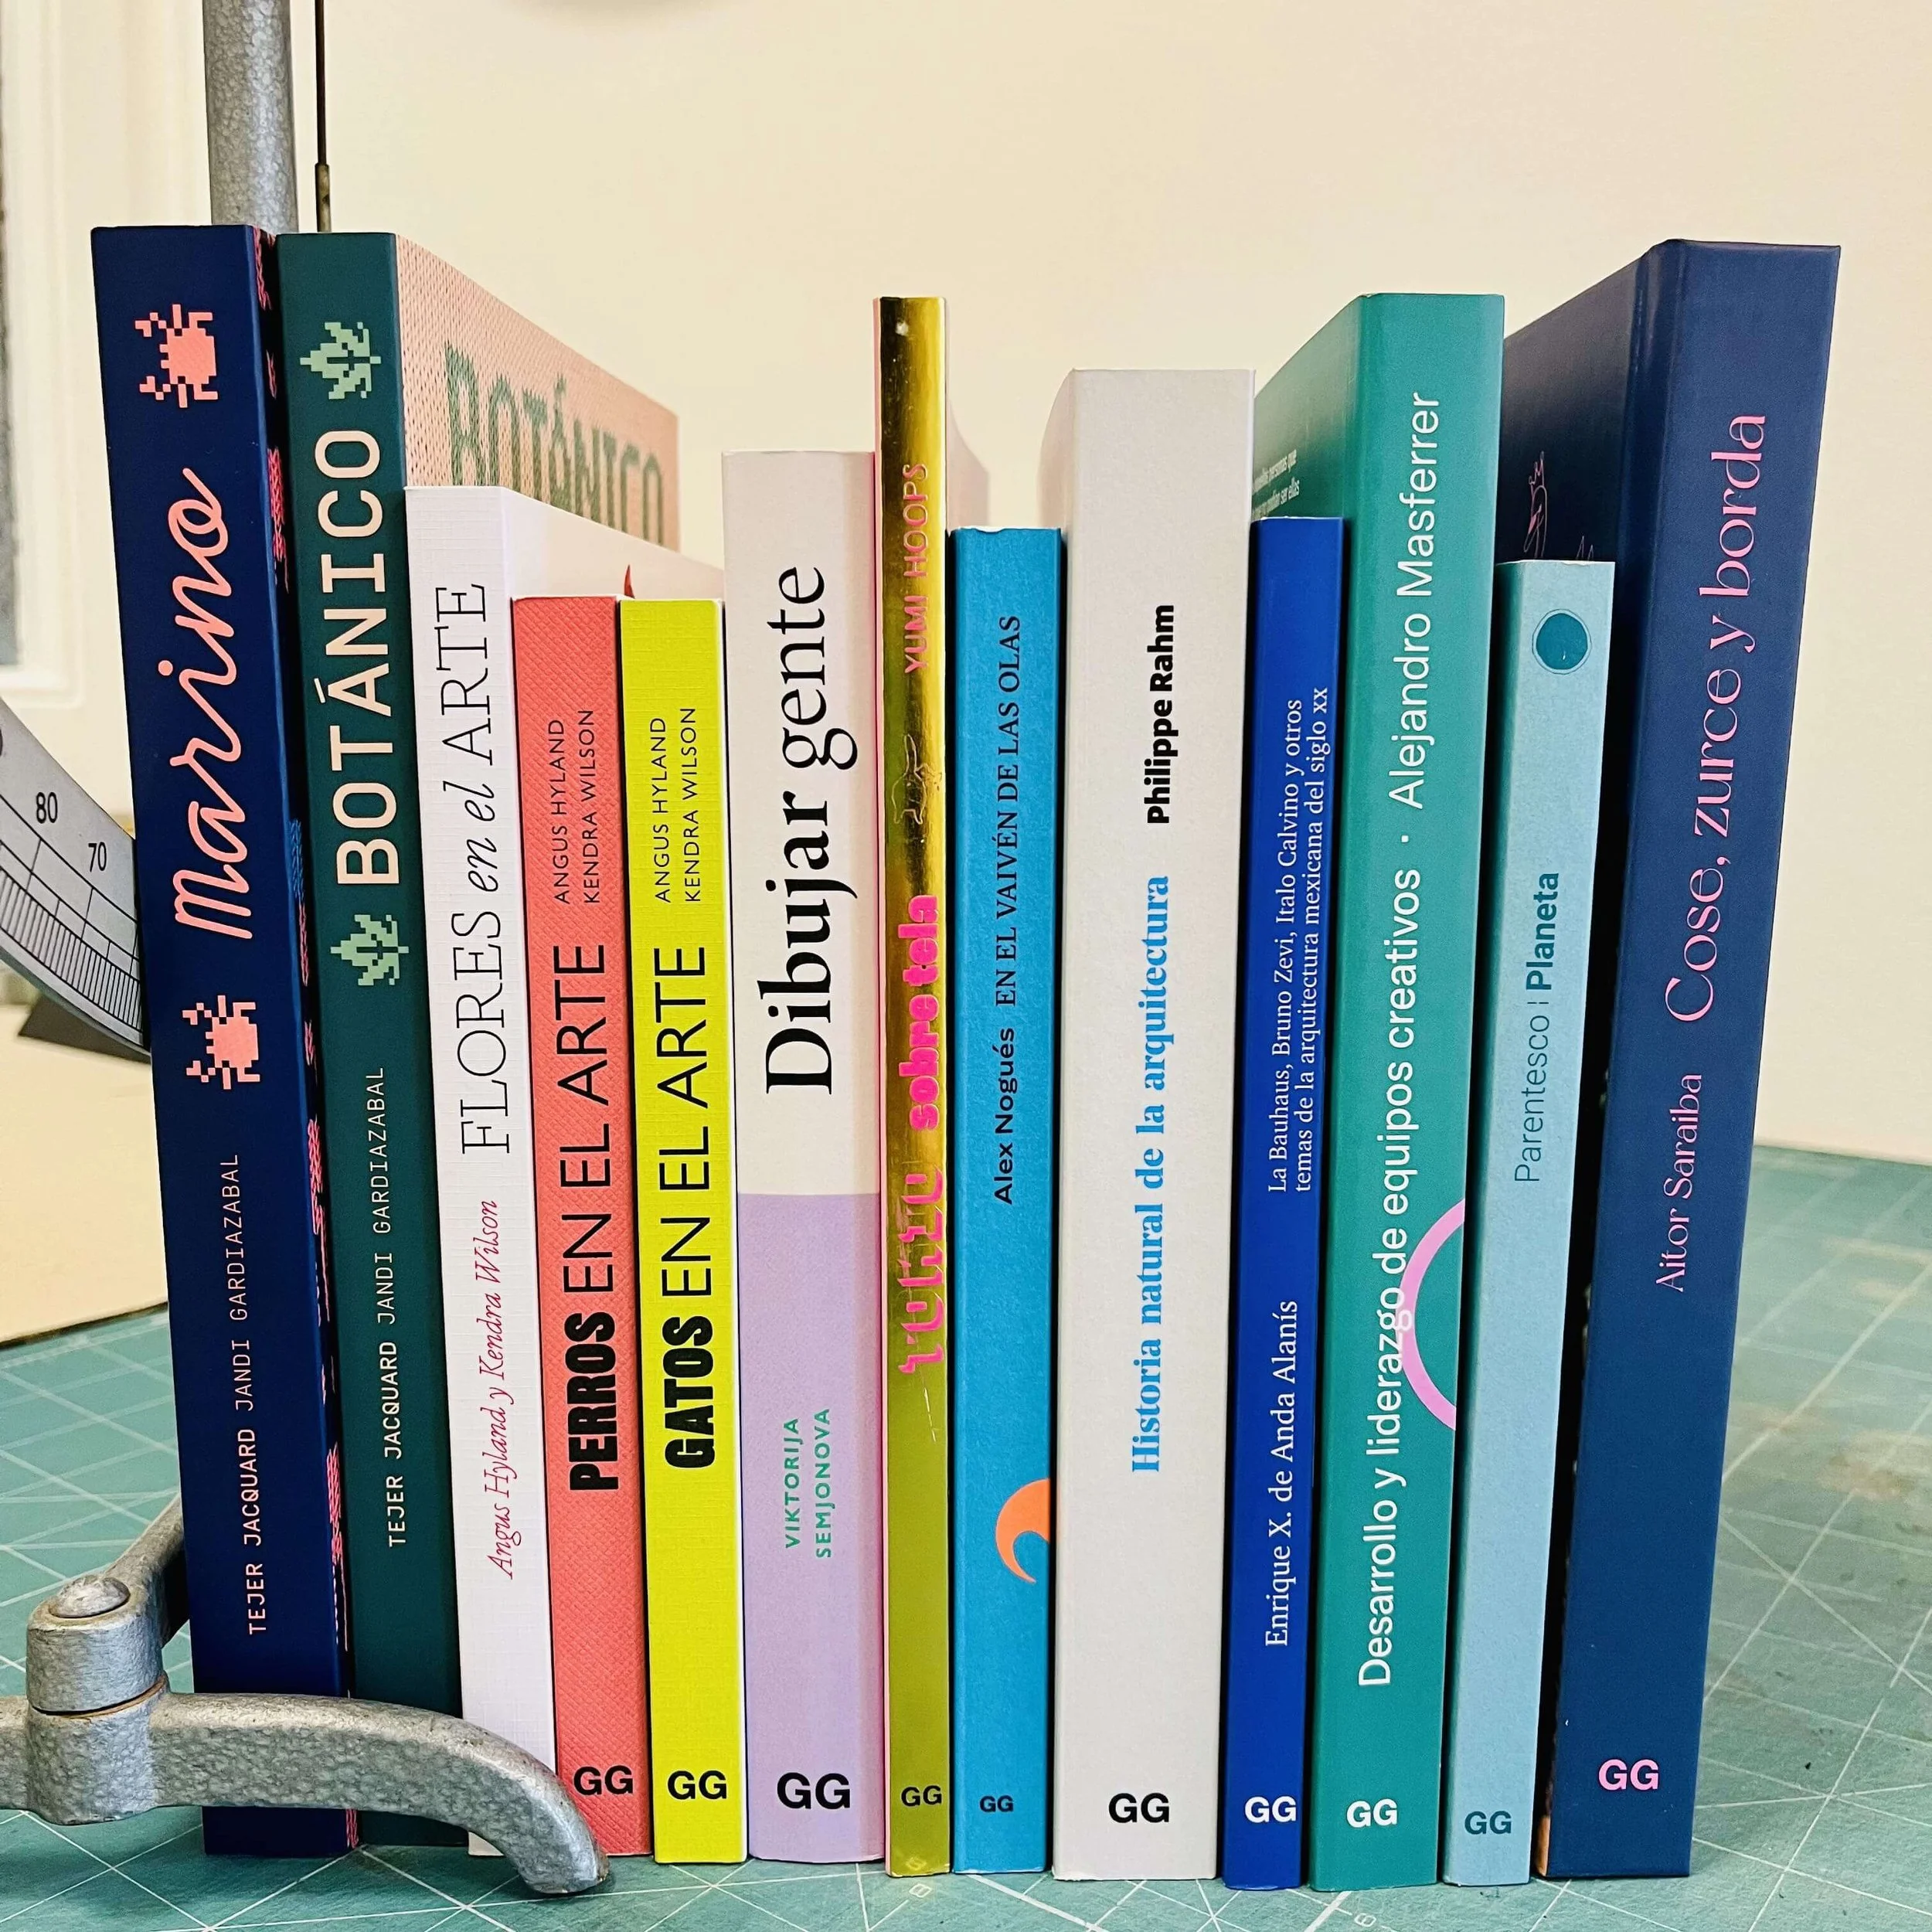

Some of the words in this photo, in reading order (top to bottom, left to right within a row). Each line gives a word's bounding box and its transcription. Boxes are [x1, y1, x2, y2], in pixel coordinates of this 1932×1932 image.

[903, 464, 928, 577] HOOPS
[1396, 393, 1438, 597] Masferrer
[1699, 417, 1765, 597] borda
[315, 430, 399, 883] BOTÁNICO
[434, 584, 492, 765] ARTE
[767, 567, 857, 770] gente
[903, 596, 927, 674] YUMI
[998, 617, 1019, 692] OLAS
[1147, 606, 1174, 691] Rahm
[1709, 615, 1756, 652] y
[998, 702, 1019, 755] LAS
[1285, 700, 1301, 756] otros
[1305, 722, 1330, 774] siglo
[1389, 614, 1434, 810] Alejandro
[1695, 669, 1740, 837] zurce
[549, 720, 566, 815] HYLAND
[578, 711, 596, 801] WILSON
[650, 719, 668, 813] HYLAND
[680, 709, 697, 800] WILSON
[998, 765, 1018, 801] DE
[1145, 700, 1179, 823] Philippe
[1286, 764, 1304, 776] y
[36, 792, 57, 824] 80
[443, 781, 495, 821] el
[1277, 784, 1298, 866] Calvino
[1304, 781, 1324, 813] del
[89, 842, 107, 872] 70
[467, 838, 498, 892] en
[552, 826, 570, 904] ANGUS
[582, 812, 600, 903] KENDRA
[653, 825, 670, 903] ANGUS
[683, 811, 700, 901] KENDRA
[992, 811, 1017, 919] VAIVÉN
[1302, 822, 1322, 923] mexicana
[1276, 875, 1295, 923] Italo
[1526, 873, 1559, 990] Planeta
[1665, 857, 1730, 1022] Cose,
[757, 791, 857, 1094] Dibujar
[898, 895, 940, 988] tela
[996, 927, 1016, 960] EL
[1274, 933, 1297, 982] Zevi,
[1384, 870, 1420, 1049] creativos
[996, 971, 1015, 1005] EN
[1138, 876, 1174, 1090] arquitectura
[1272, 992, 1291, 1055] Bruno
[1298, 934, 1321, 1063] arquitectura
[451, 912, 509, 1154] FLORES
[553, 945, 608, 1106] ARTE
[654, 947, 708, 1108] ARTE
[898, 995, 940, 1131] sobre
[992, 1029, 1017, 1133] Nogués
[1136, 1104, 1164, 1134] la
[1269, 1064, 1294, 1159] Bauhaus,
[1294, 1072, 1314, 1089] la
[1294, 1097, 1313, 1122] de
[1515, 1015, 1549, 1181] Parentesco
[366, 1068, 390, 1233] GARDIAZABAL
[560, 1124, 611, 1187] EL
[659, 1127, 709, 1190] EL
[995, 1143, 1012, 1204] Alex
[1135, 1149, 1163, 1189] de
[1295, 1130, 1312, 1191] temas
[1377, 1063, 1419, 1215] equipos
[1664, 1075, 1702, 1199] Saraiba
[1268, 1168, 1286, 1192] La
[220, 1155, 247, 1320] GARDIAZABAL
[473, 1201, 500, 1283] Wilson
[562, 1214, 613, 1292] EN
[661, 1218, 711, 1296] EN
[1134, 1204, 1162, 1324] natural
[1372, 1228, 1408, 1276] de
[1656, 1209, 1689, 1291] Aitor
[375, 1253, 395, 1324] JANDI
[232, 1340, 253, 1410] JANDI
[477, 1293, 504, 1379] Kendra
[1271, 1301, 1297, 1383] Alanís
[1366, 1286, 1413, 1455] liderazgo
[379, 1342, 401, 1459] JACQUARD
[489, 1386, 514, 1405] y
[564, 1312, 619, 1491] PERROS
[662, 1316, 716, 1468] GATOS
[1132, 1339, 1161, 1472] Historia
[1270, 1393, 1294, 1462] Anda
[238, 1430, 261, 1546] JACQUARD
[481, 1407, 517, 1498] Hyland
[784, 1419, 803, 1548] VIKTORIJA
[815, 1409, 835, 1557] SEMJONOVA
[1268, 1471, 1292, 1502] de
[1375, 1468, 1406, 1488] y
[386, 1477, 406, 1546] TEJER
[488, 1504, 521, 1580] Angus
[1269, 1512, 1291, 1537] X.
[246, 1564, 266, 1634] TEJER
[1266, 1546, 1296, 1645] Enrique
[1358, 1500, 1397, 1685] Desarrollo
[574, 1766, 633, 1795] GG
[668, 1770, 726, 1800] GG
[777, 1773, 850, 1809] GG
[902, 1786, 941, 1806] GG
[980, 1795, 1013, 1812] GG
[1109, 1793, 1169, 1823] GG
[1245, 1796, 1296, 1822] GG
[1346, 1799, 1397, 1827] GG
[1599, 1760, 1658, 1790] GG
[1465, 1811, 1511, 1835] GG
